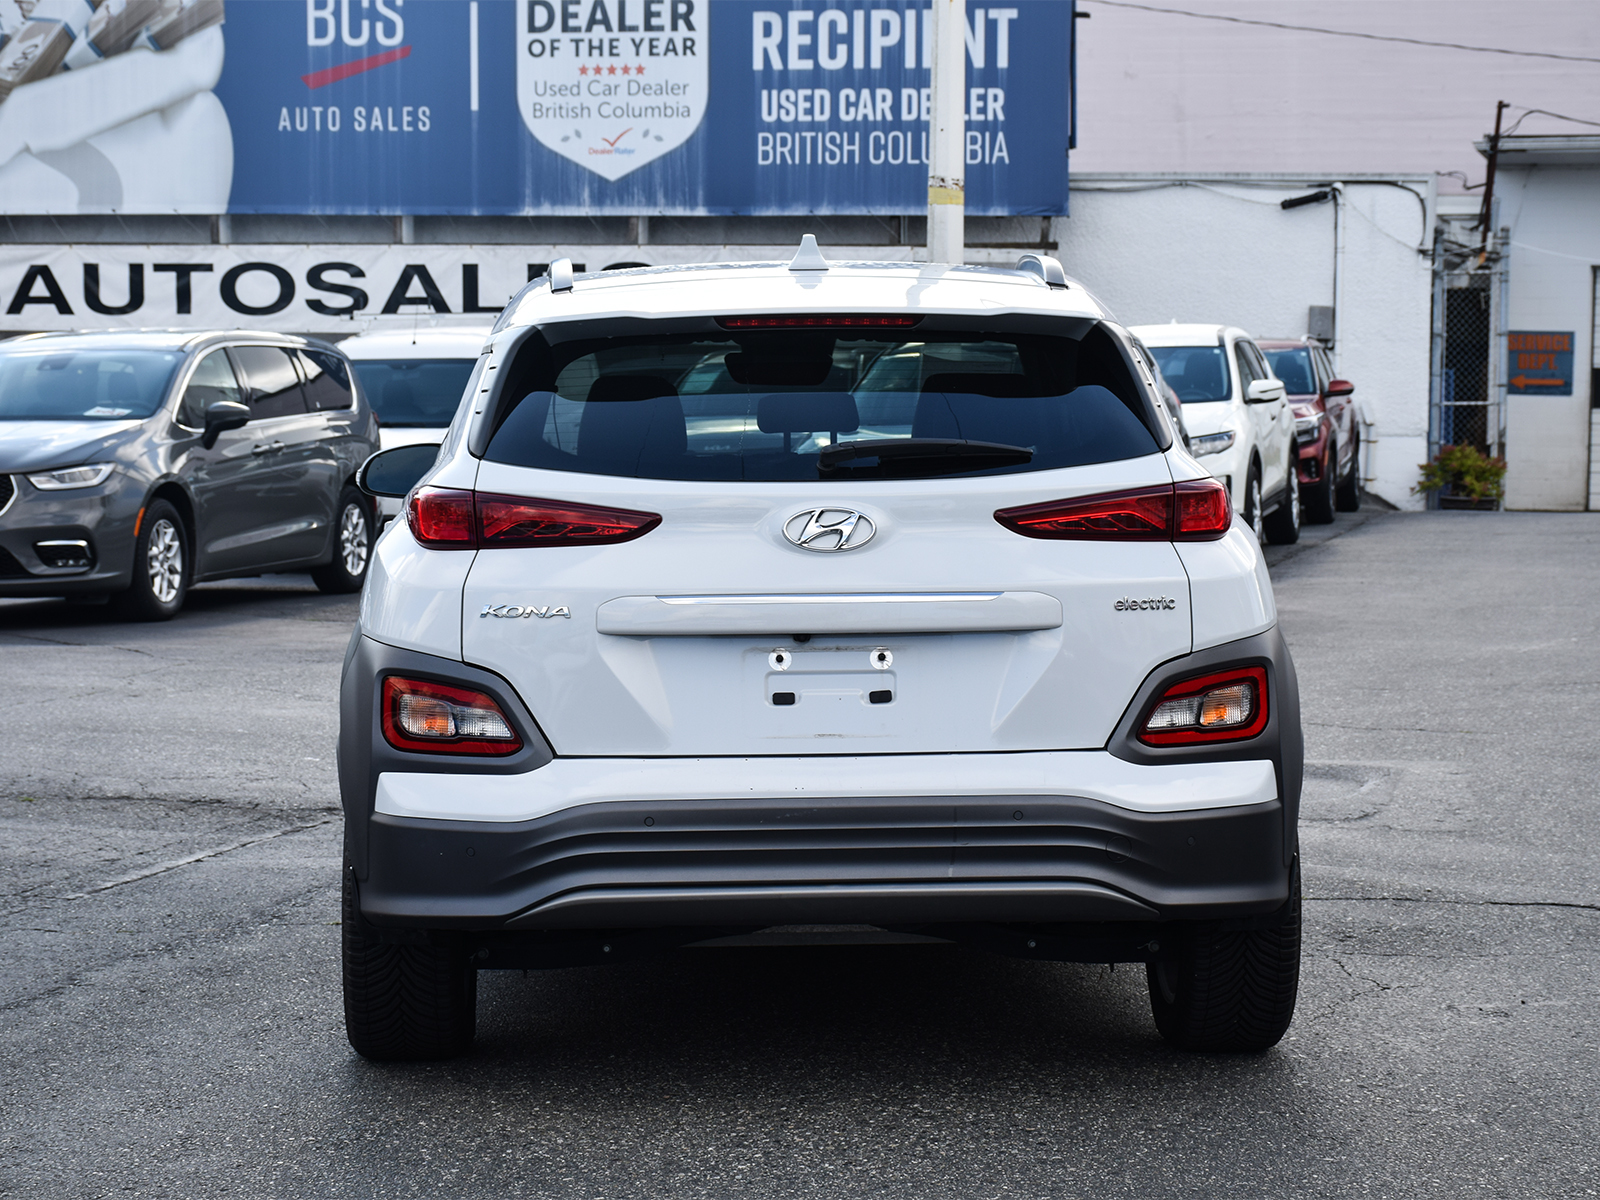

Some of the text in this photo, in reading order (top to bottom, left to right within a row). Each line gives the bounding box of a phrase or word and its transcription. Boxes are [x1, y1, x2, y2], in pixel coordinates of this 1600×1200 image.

[307, 0, 404, 46] BCS
[527, 0, 697, 33] DEALER
[528, 37, 697, 58] OF THE YEAR
[534, 79, 689, 97] Used Car Dealer
[532, 101, 691, 119] British Columbia
[761, 87, 1005, 122] USED CAR DEER
[278, 106, 431, 132] AUTO SALES
[758, 131, 859, 165] BRITISH
[5, 262, 651, 316] AUTOSAL
[1508, 334, 1570, 351] SERVICE
[1518, 353, 1558, 370] DEPT.
[480, 604, 571, 619] KONA
[1114, 595, 1176, 611] electric
